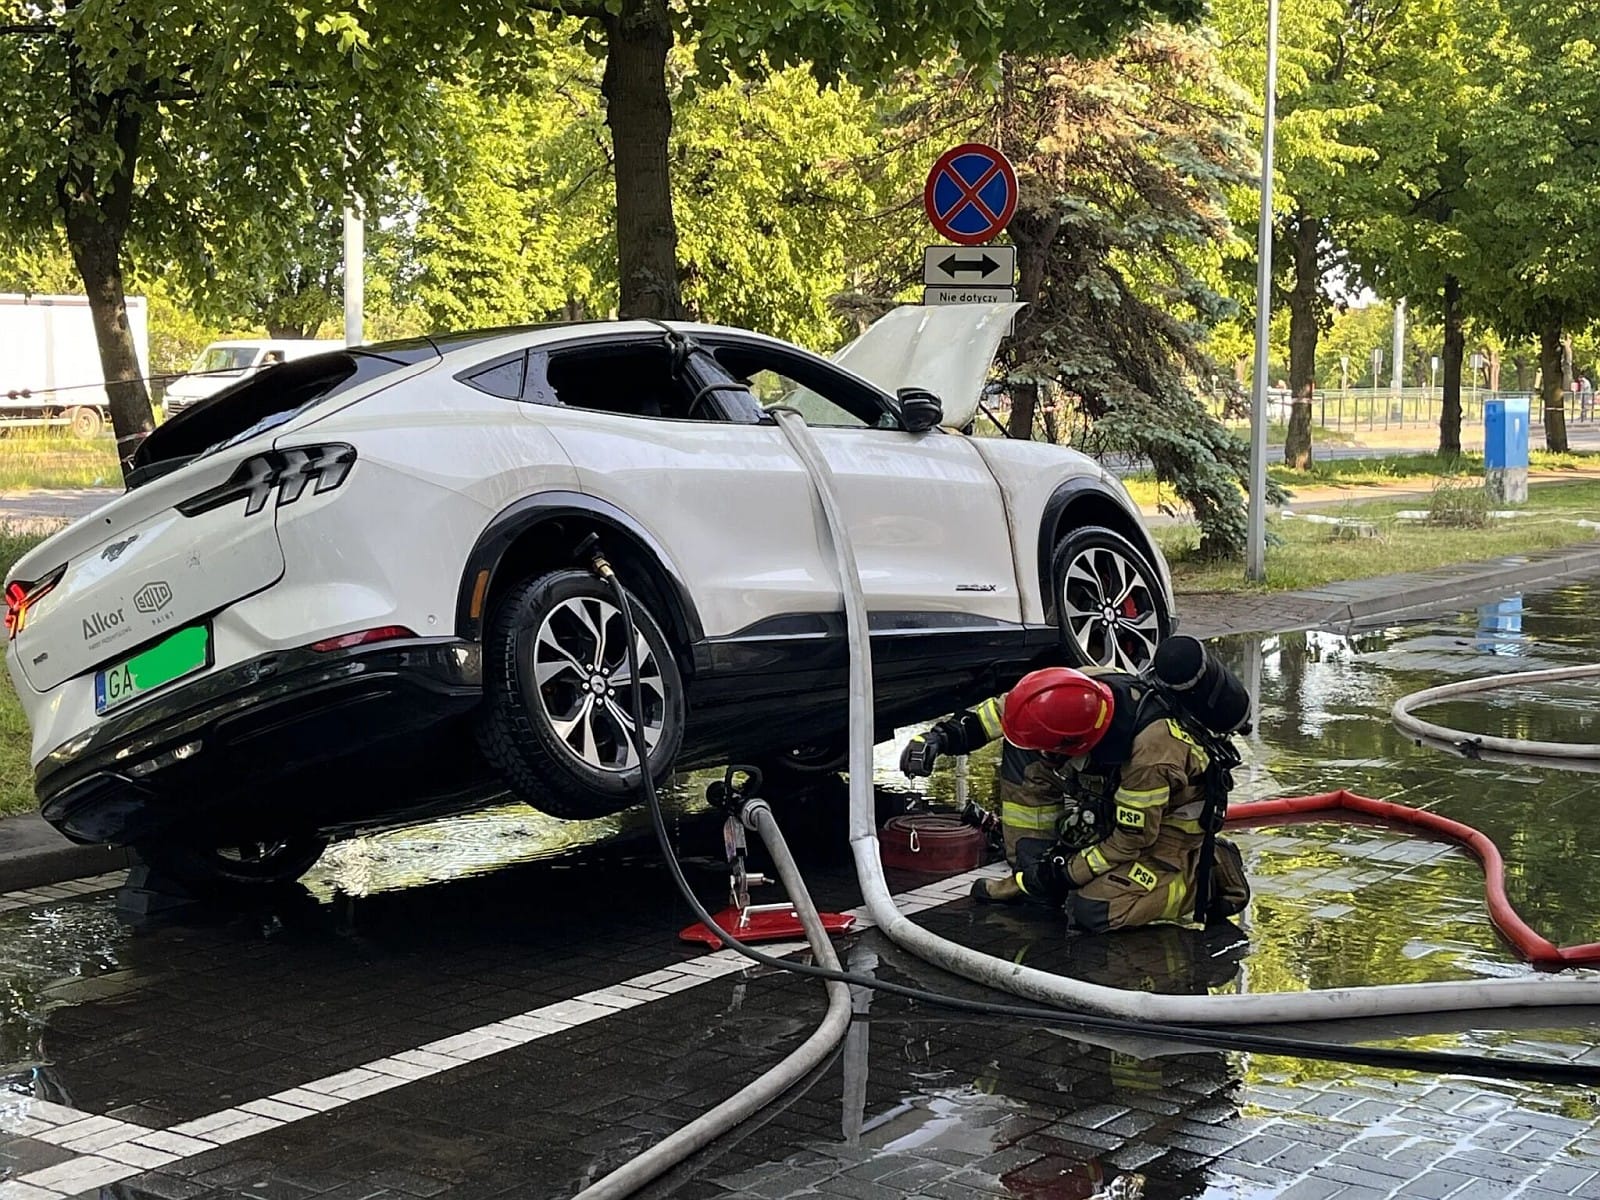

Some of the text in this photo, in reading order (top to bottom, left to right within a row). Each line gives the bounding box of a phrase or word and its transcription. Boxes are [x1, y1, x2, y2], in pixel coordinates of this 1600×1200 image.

[940, 292, 997, 303] Nie dotyczy
[82, 608, 125, 640] Alkor
[110, 664, 133, 698] GA
[1120, 810, 1140, 824] PSP
[1134, 867, 1153, 885] PSP
